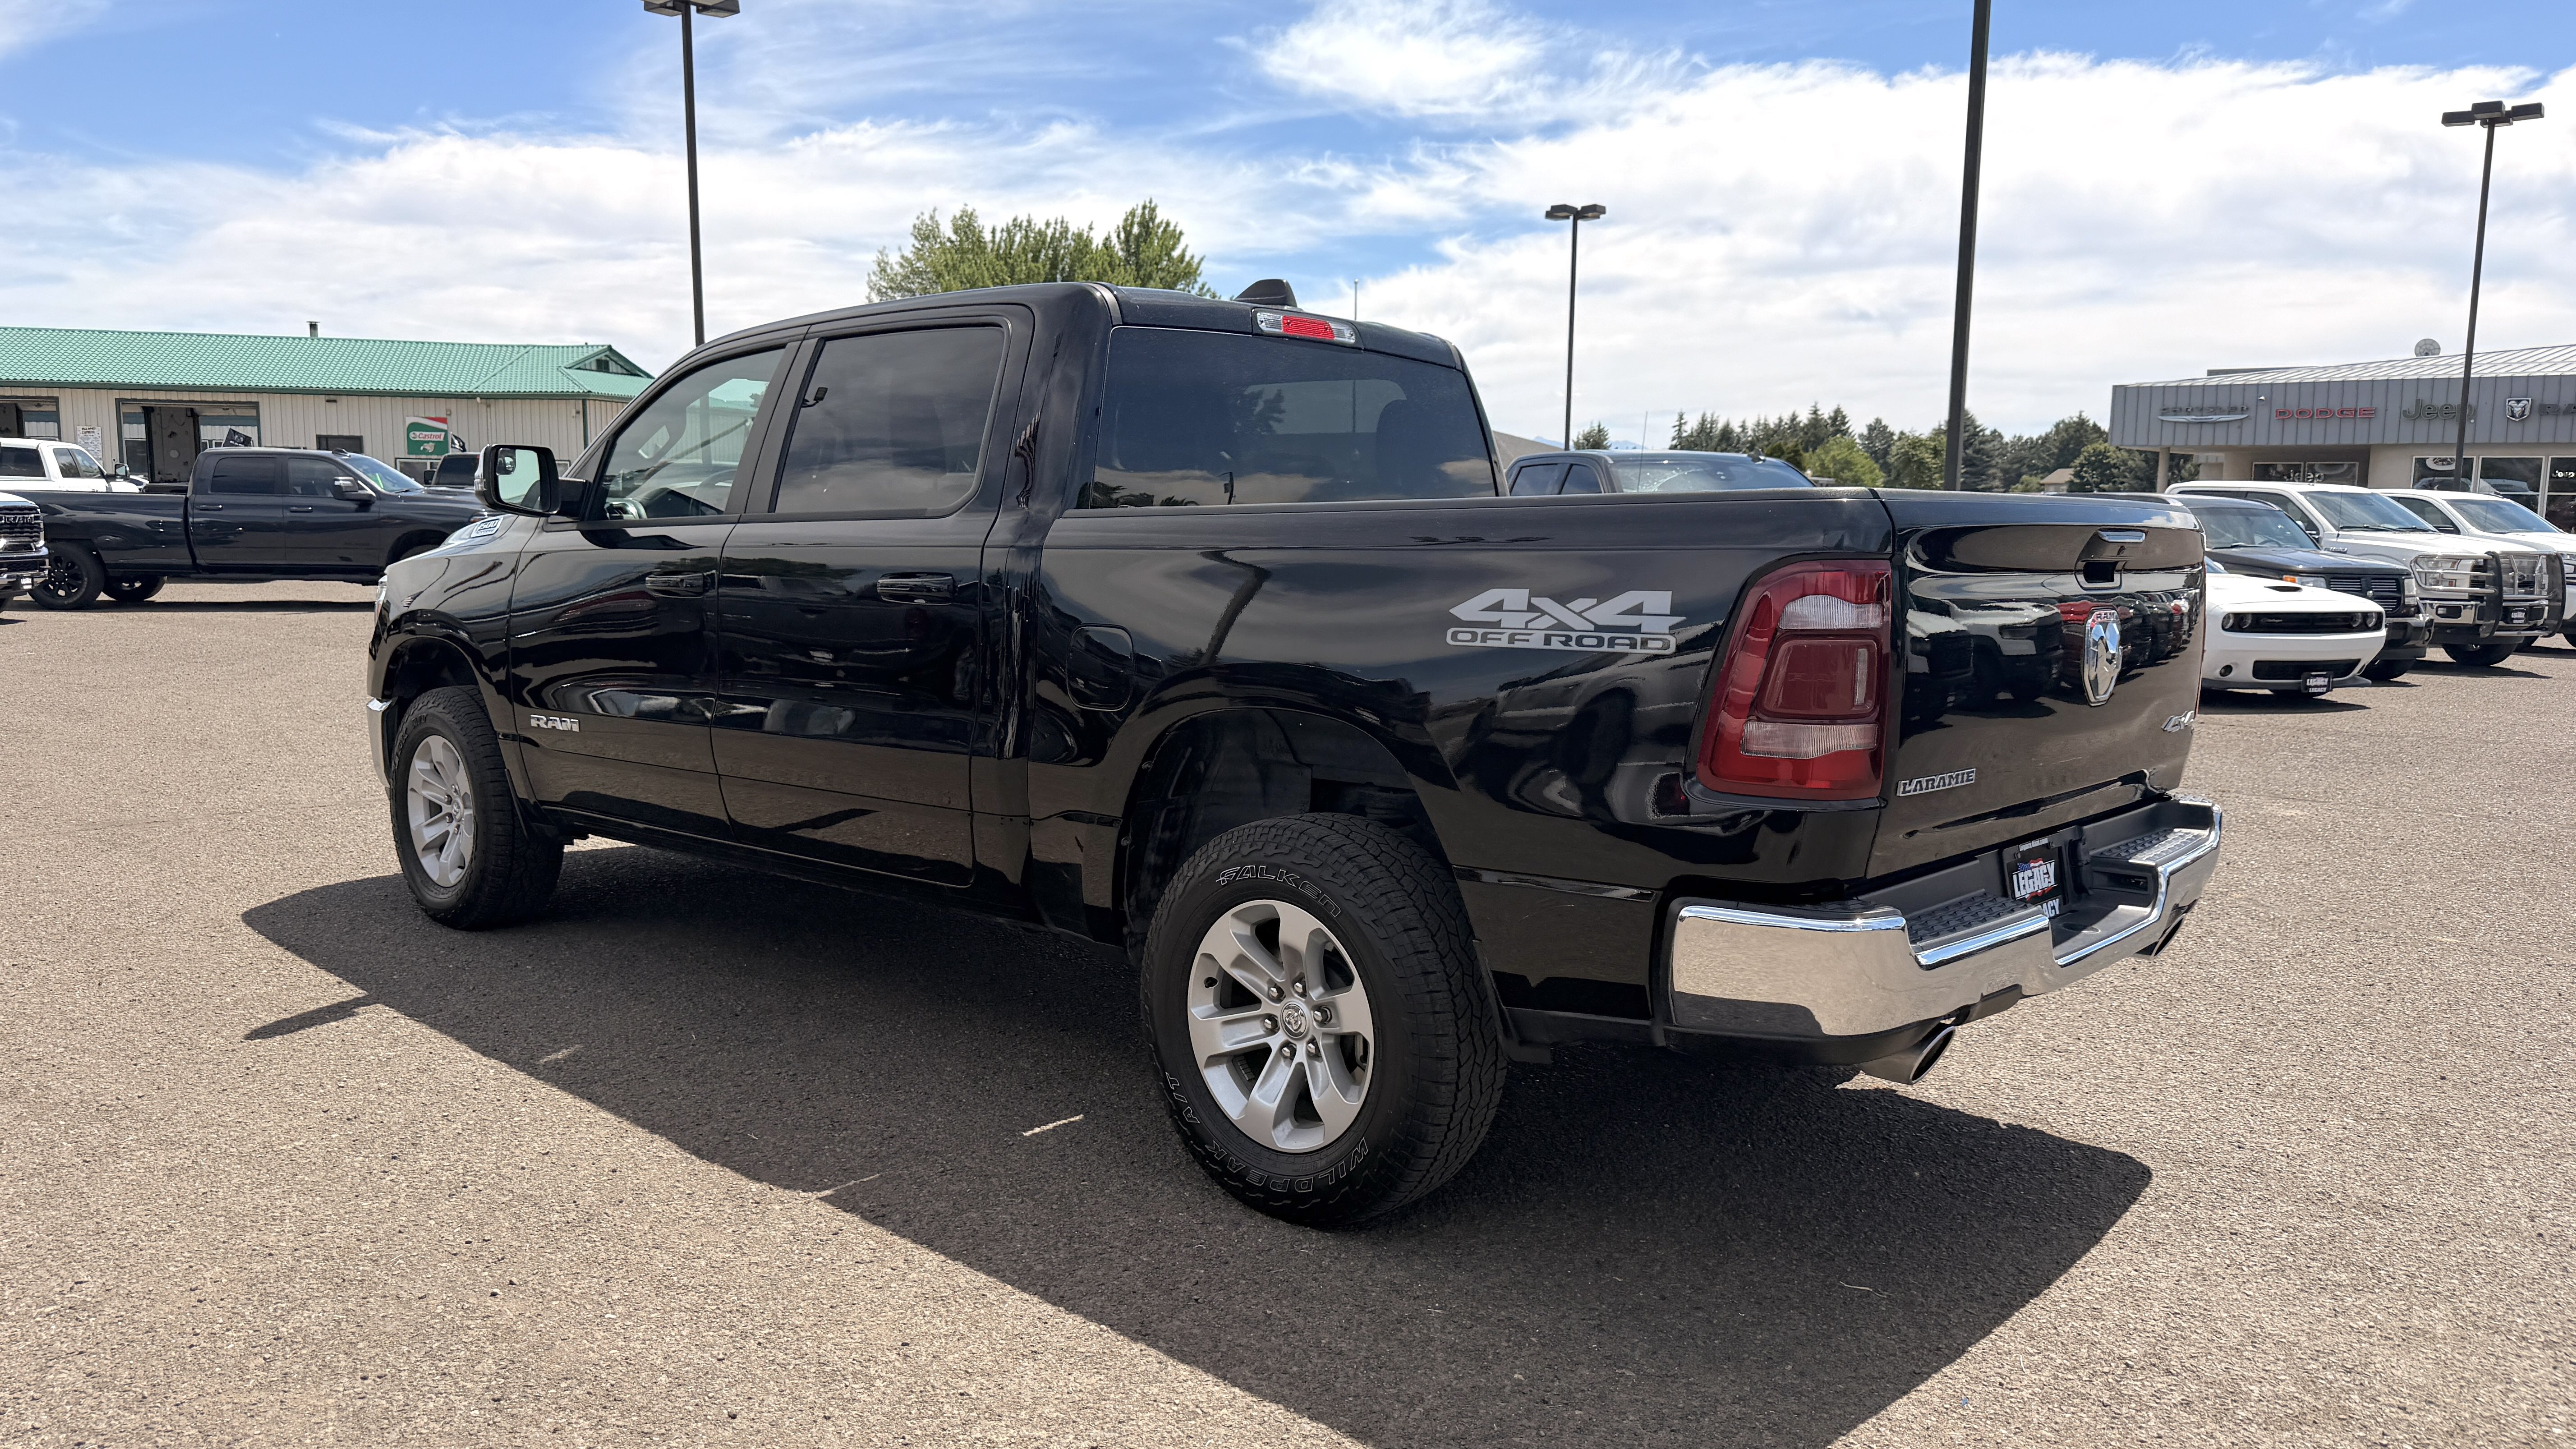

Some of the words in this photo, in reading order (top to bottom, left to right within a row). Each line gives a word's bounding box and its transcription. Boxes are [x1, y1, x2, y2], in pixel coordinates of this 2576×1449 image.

[2275, 407, 2376, 419] DODGE
[2402, 398, 2475, 423] Jeep
[1449, 588, 1687, 633] 4x4
[1450, 630, 1535, 645] OFF
[1543, 633, 1671, 651] ROAD
[530, 714, 580, 732] RAM
[1900, 769, 1975, 795] LARAMIE
[2013, 862, 2055, 898] LEGACY
[2042, 898, 2060, 919] ACY
[1205, 1136, 1369, 1192] WILDPEAK
